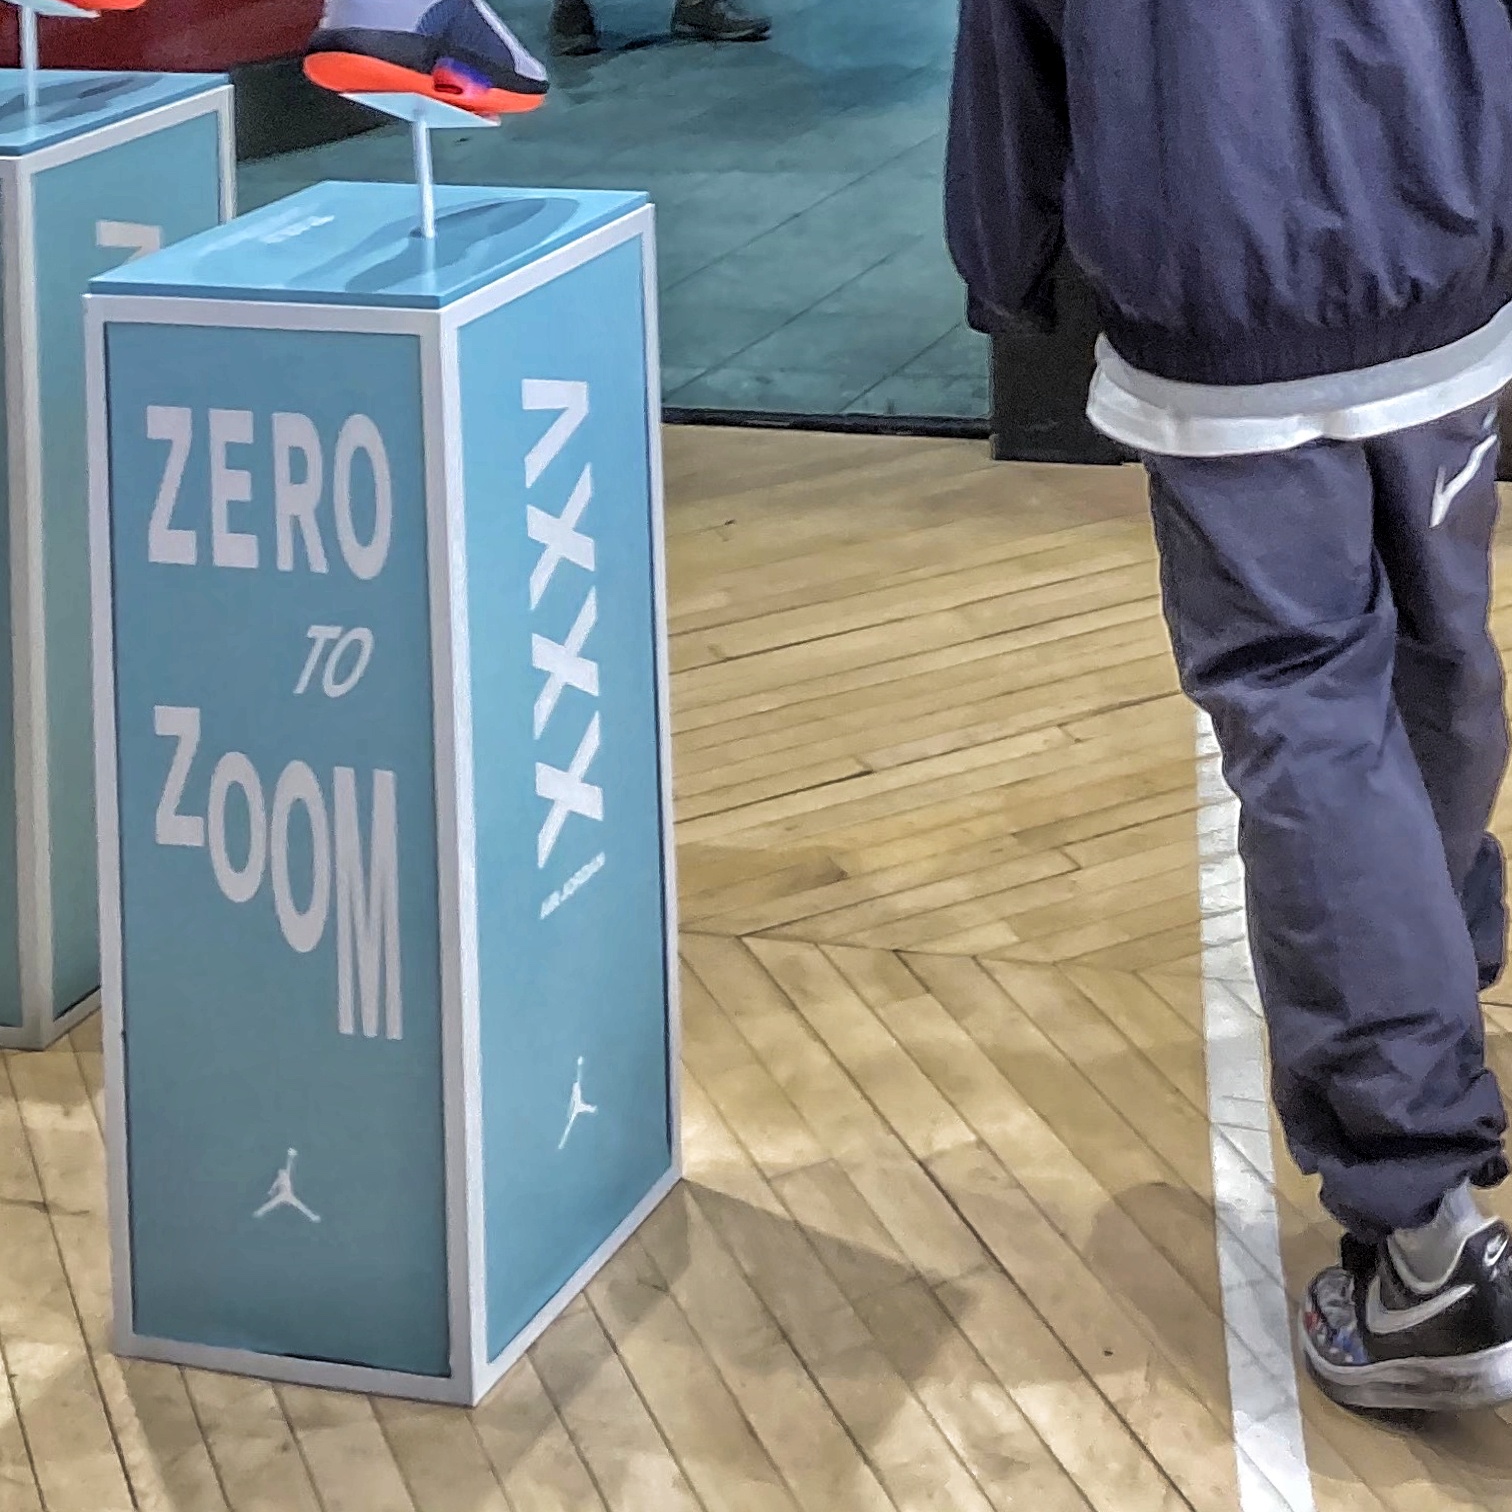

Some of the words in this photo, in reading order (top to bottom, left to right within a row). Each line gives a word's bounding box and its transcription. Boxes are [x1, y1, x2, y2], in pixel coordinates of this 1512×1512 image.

[146, 405, 393, 580] ZERO
[293, 624, 374, 698] TO
[154, 704, 403, 1041] ZOOM
